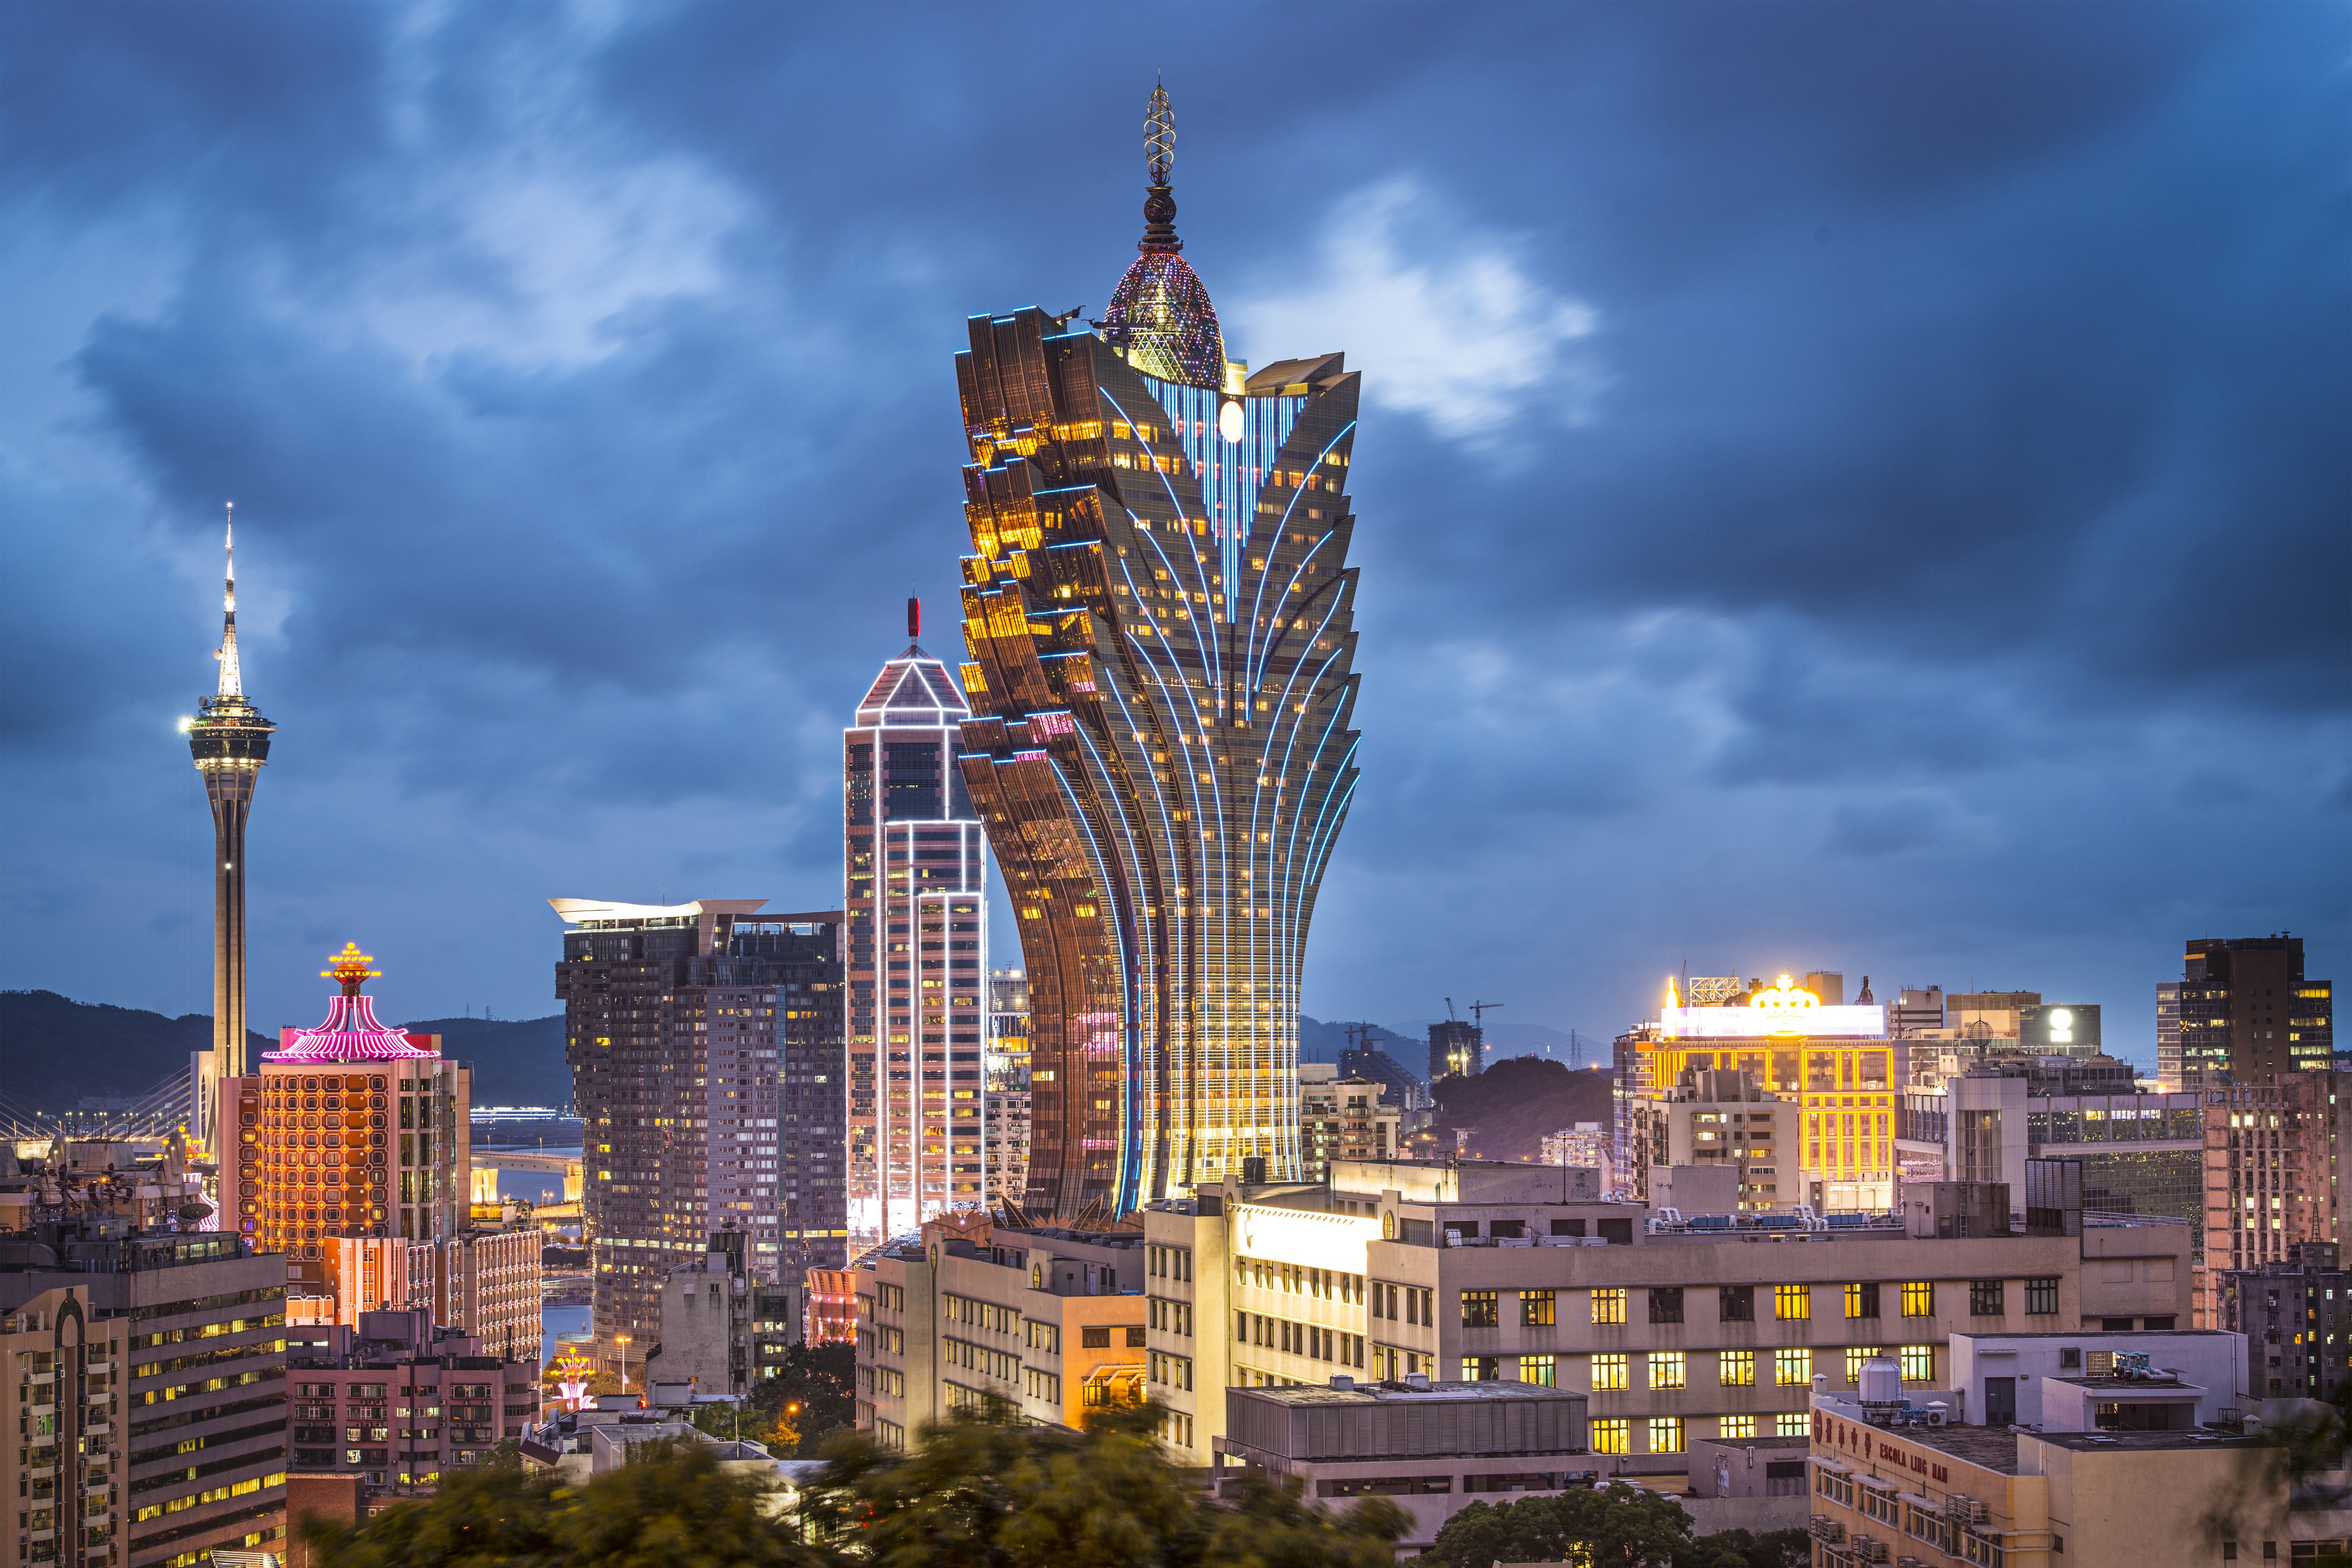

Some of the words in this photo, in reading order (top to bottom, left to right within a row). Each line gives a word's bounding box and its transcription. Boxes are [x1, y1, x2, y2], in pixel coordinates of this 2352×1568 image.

[1880, 1443, 1906, 1467] ESCOLA
[1910, 1455, 1927, 1475] LING
[1932, 1463, 1947, 1483] NAN
